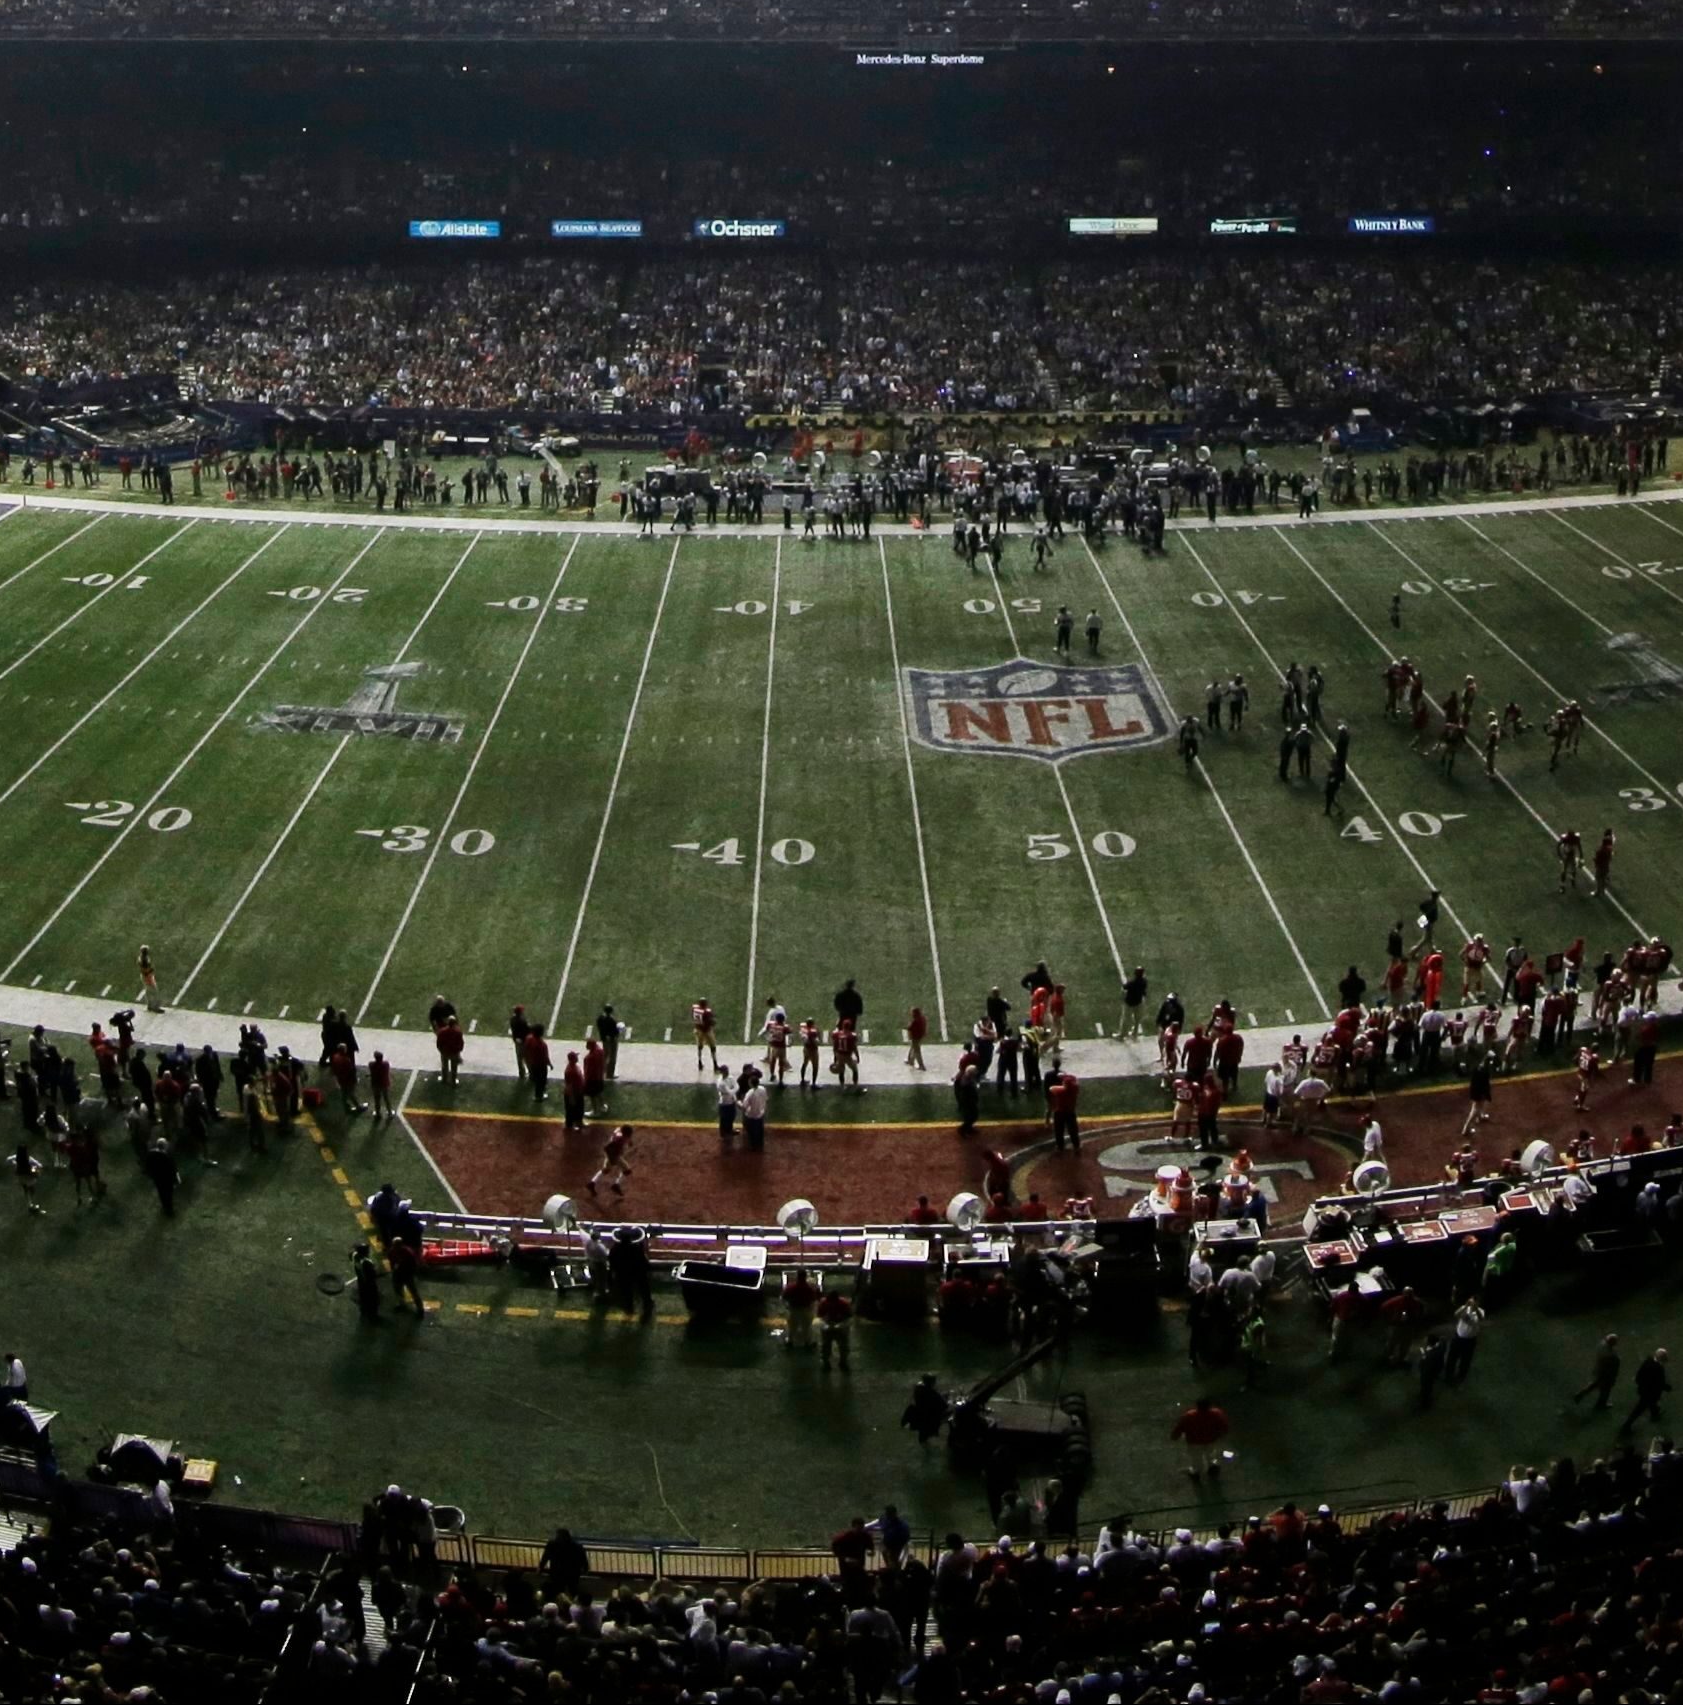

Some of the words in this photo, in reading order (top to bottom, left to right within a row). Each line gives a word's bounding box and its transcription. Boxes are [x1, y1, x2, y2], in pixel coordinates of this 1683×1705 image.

[857, 54, 926, 64] Mercedes-Benz
[931, 54, 984, 66] Superdome
[441, 222, 487, 236] Allstate
[711, 220, 776, 237] Ochsner
[1355, 219, 1398, 232] WHITNEY
[1399, 219, 1425, 231] BANK
[1601, 561, 1676, 580] 20
[82, 572, 152, 589] 10
[1401, 577, 1480, 595] 30
[289, 585, 369, 602] 20
[1191, 590, 1265, 605] 40
[508, 596, 589, 612] 30
[732, 599, 814, 616] 40
[963, 599, 1042, 614] 50
[939, 699, 1144, 746] NFL
[81, 800, 192, 831] 20
[1340, 810, 1443, 844] 40
[382, 825, 495, 855] 30
[1027, 832, 1136, 860] 50
[701, 837, 815, 866] 40
